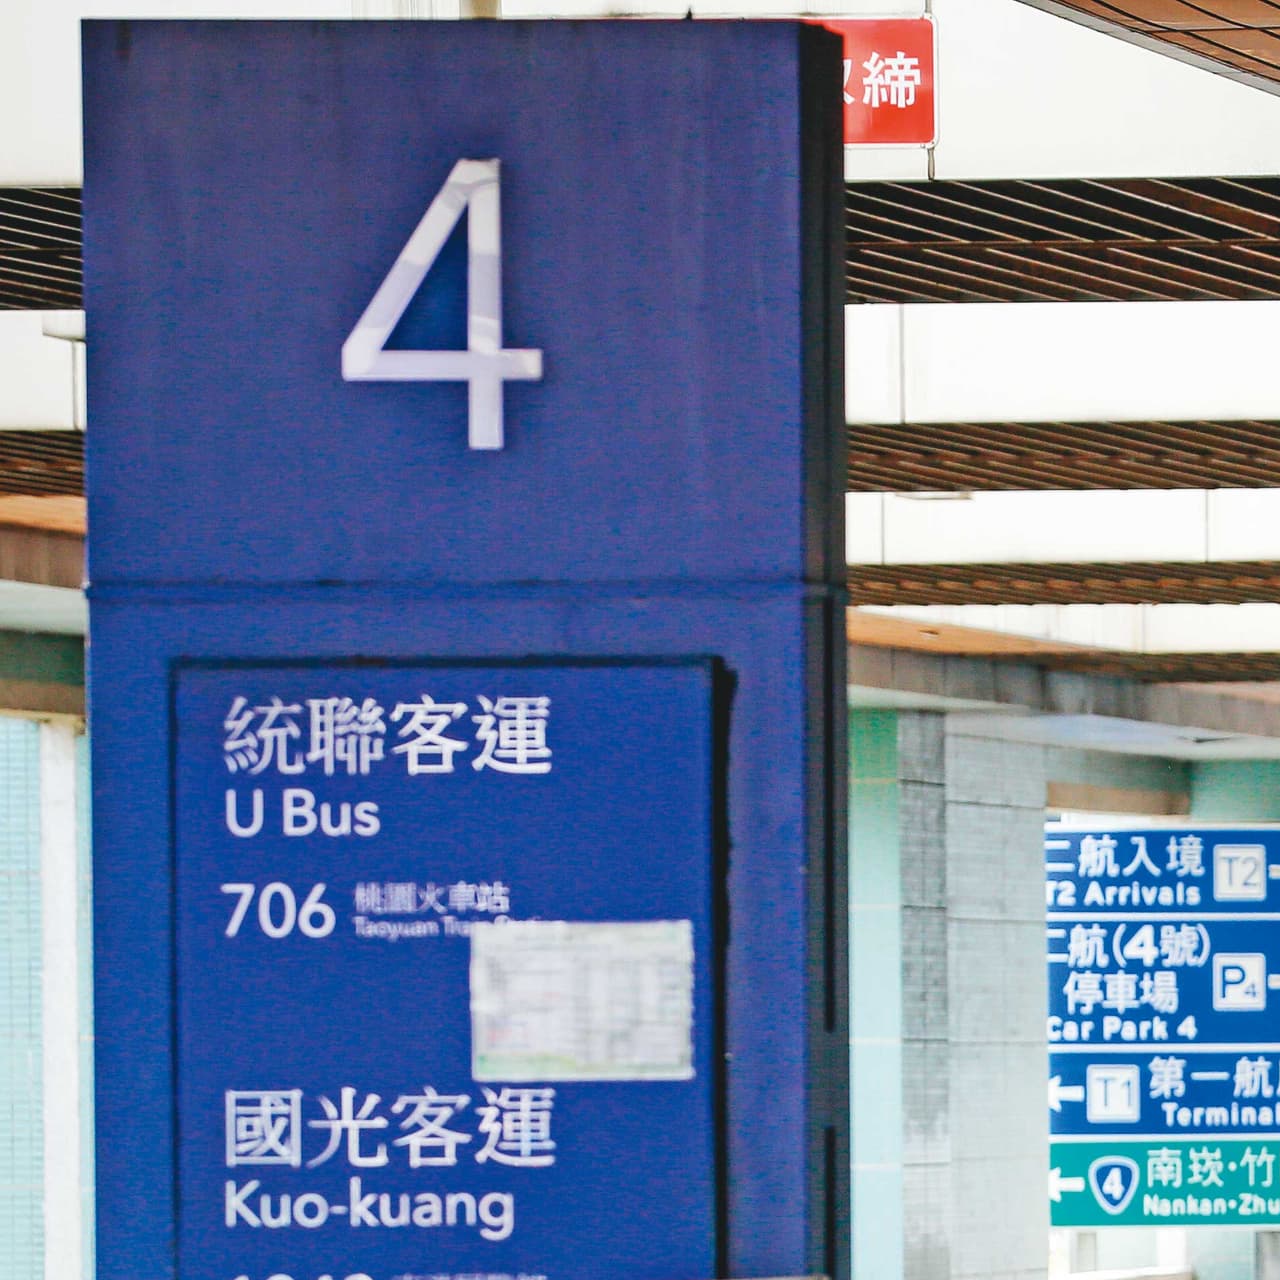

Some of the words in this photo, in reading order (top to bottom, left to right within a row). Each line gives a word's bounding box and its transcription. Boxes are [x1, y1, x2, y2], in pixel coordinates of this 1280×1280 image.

[340, 157, 543, 451] 4
[223, 693, 554, 776] 統聯客運
[225, 788, 264, 838] U
[282, 787, 381, 837] Bus
[1044, 834, 1206, 877] 二航入境
[1221, 855, 1260, 888] T2
[220, 881, 336, 939] 706
[1083, 880, 1202, 906] Arrivals
[1062, 969, 1180, 1014] 停車場
[1046, 1015, 1095, 1041] Car
[1102, 1015, 1168, 1041] Park
[1177, 1014, 1198, 1040] 4
[224, 1085, 556, 1169] 國光客運
[1102, 1167, 1126, 1201] 4
[224, 1175, 515, 1242] Kuo-kuang
